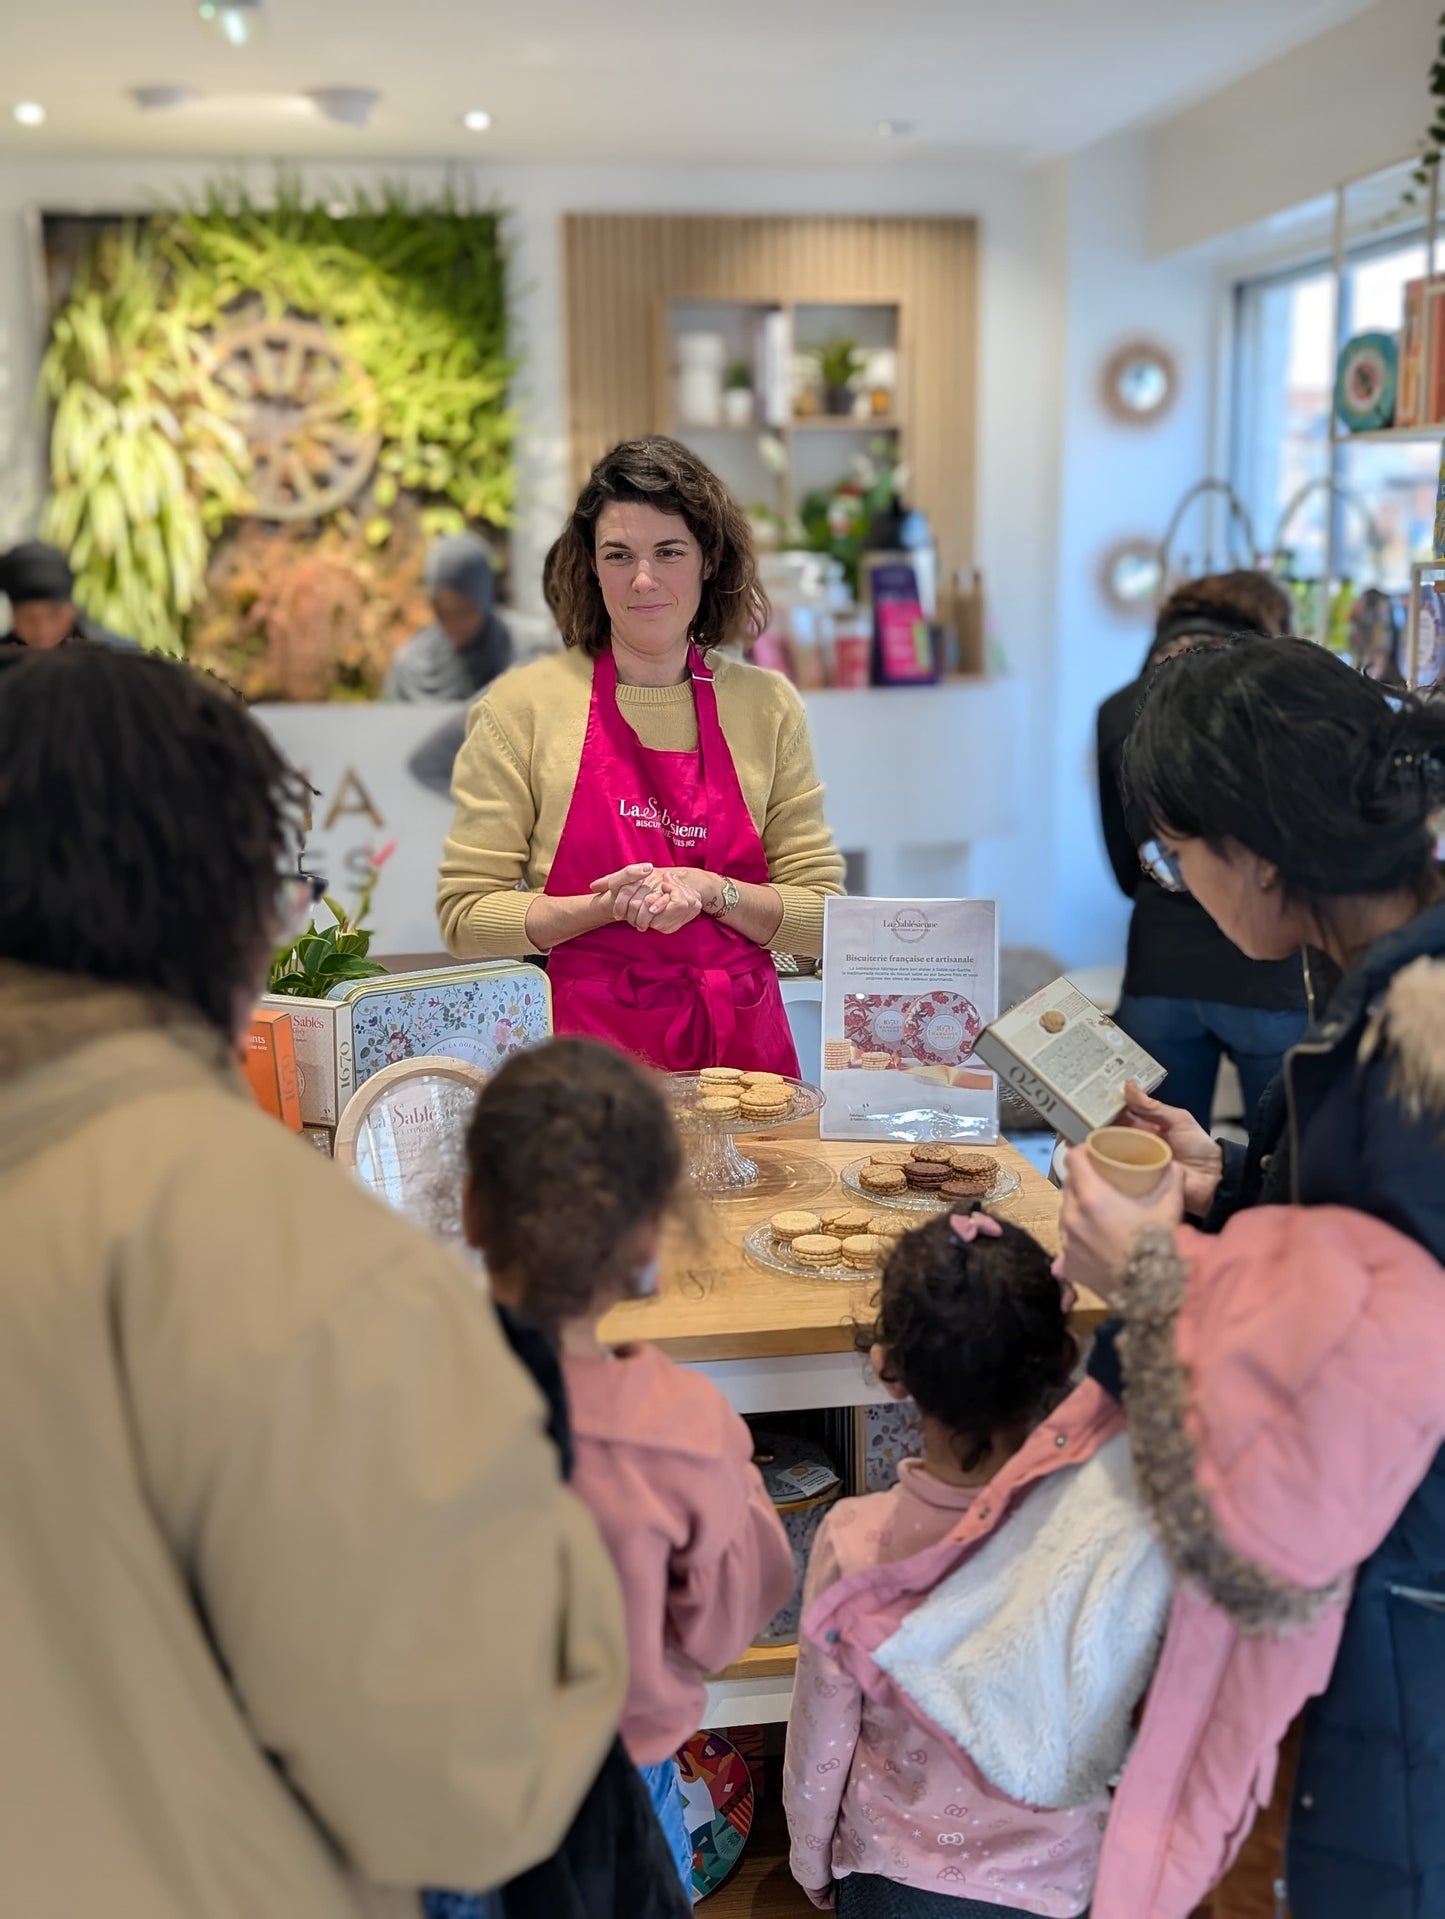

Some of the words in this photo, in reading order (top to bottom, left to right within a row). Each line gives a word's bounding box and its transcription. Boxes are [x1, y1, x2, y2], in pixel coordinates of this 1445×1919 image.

[619, 799, 640, 817] La
[883, 919, 893, 928] La
[893, 917, 938, 929] Sablésienne
[846, 954, 888, 962] Biscuiterie
[889, 954, 925, 963] française
[935, 955, 974, 963] artisanale
[293, 1015, 324, 1029] Sablés
[340, 1041, 352, 1089] 1670
[1009, 1066, 1057, 1113] 1670
